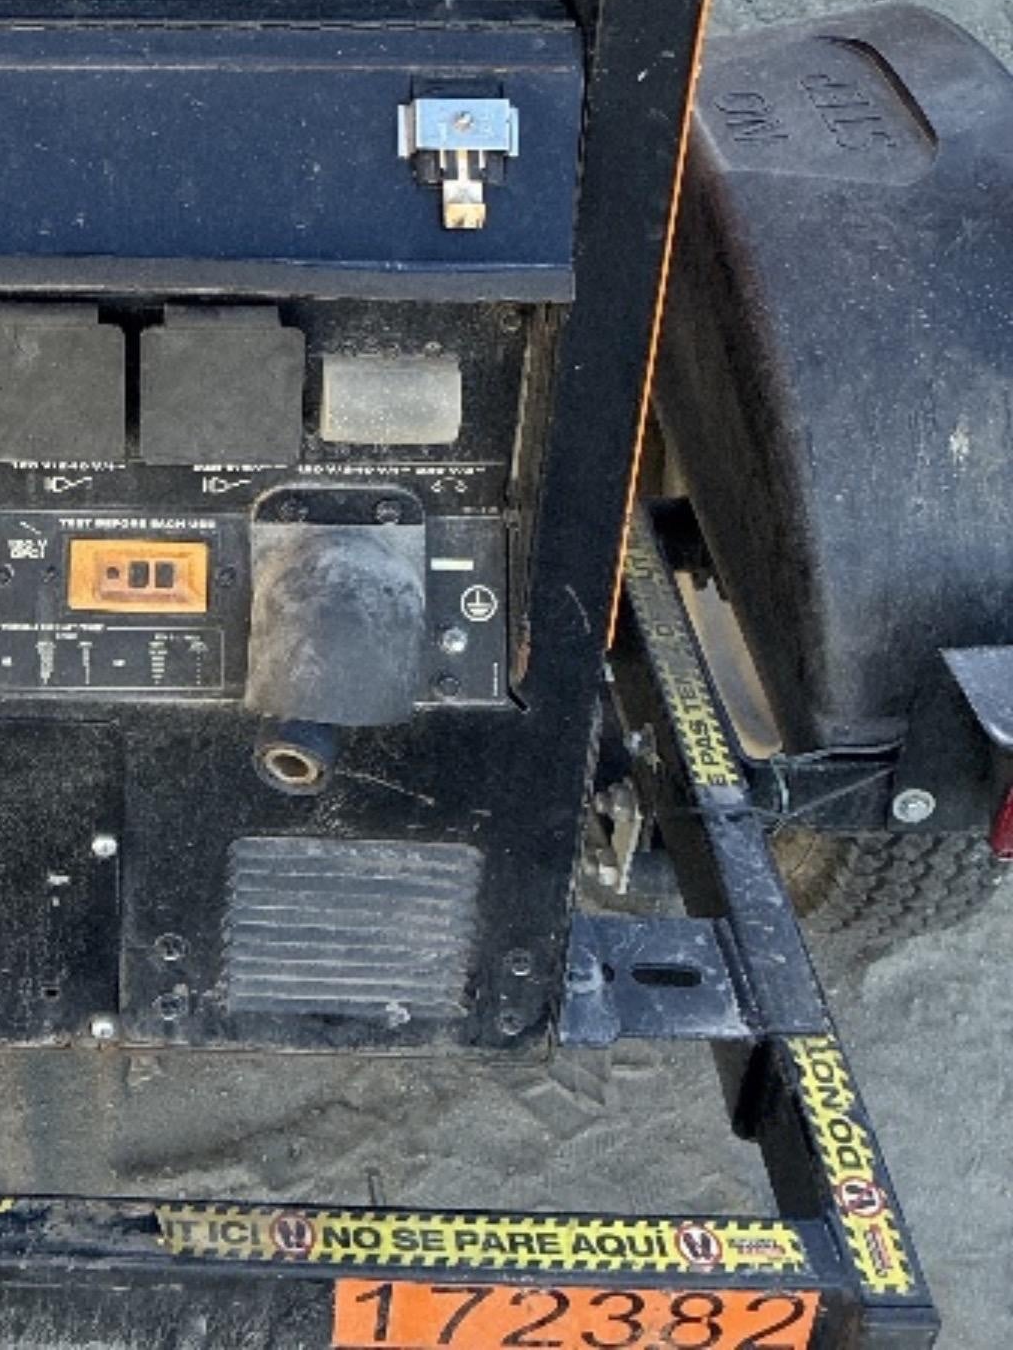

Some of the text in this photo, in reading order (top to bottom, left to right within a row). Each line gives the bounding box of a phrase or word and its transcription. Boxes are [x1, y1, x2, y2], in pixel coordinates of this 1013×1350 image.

[827, 1117, 864, 1171] DO
[208, 1220, 261, 1246] ICI
[323, 1225, 382, 1250] NO
[390, 1228, 446, 1252] SE
[454, 1229, 562, 1255] PARE
[355, 1282, 806, 1350] 172382
